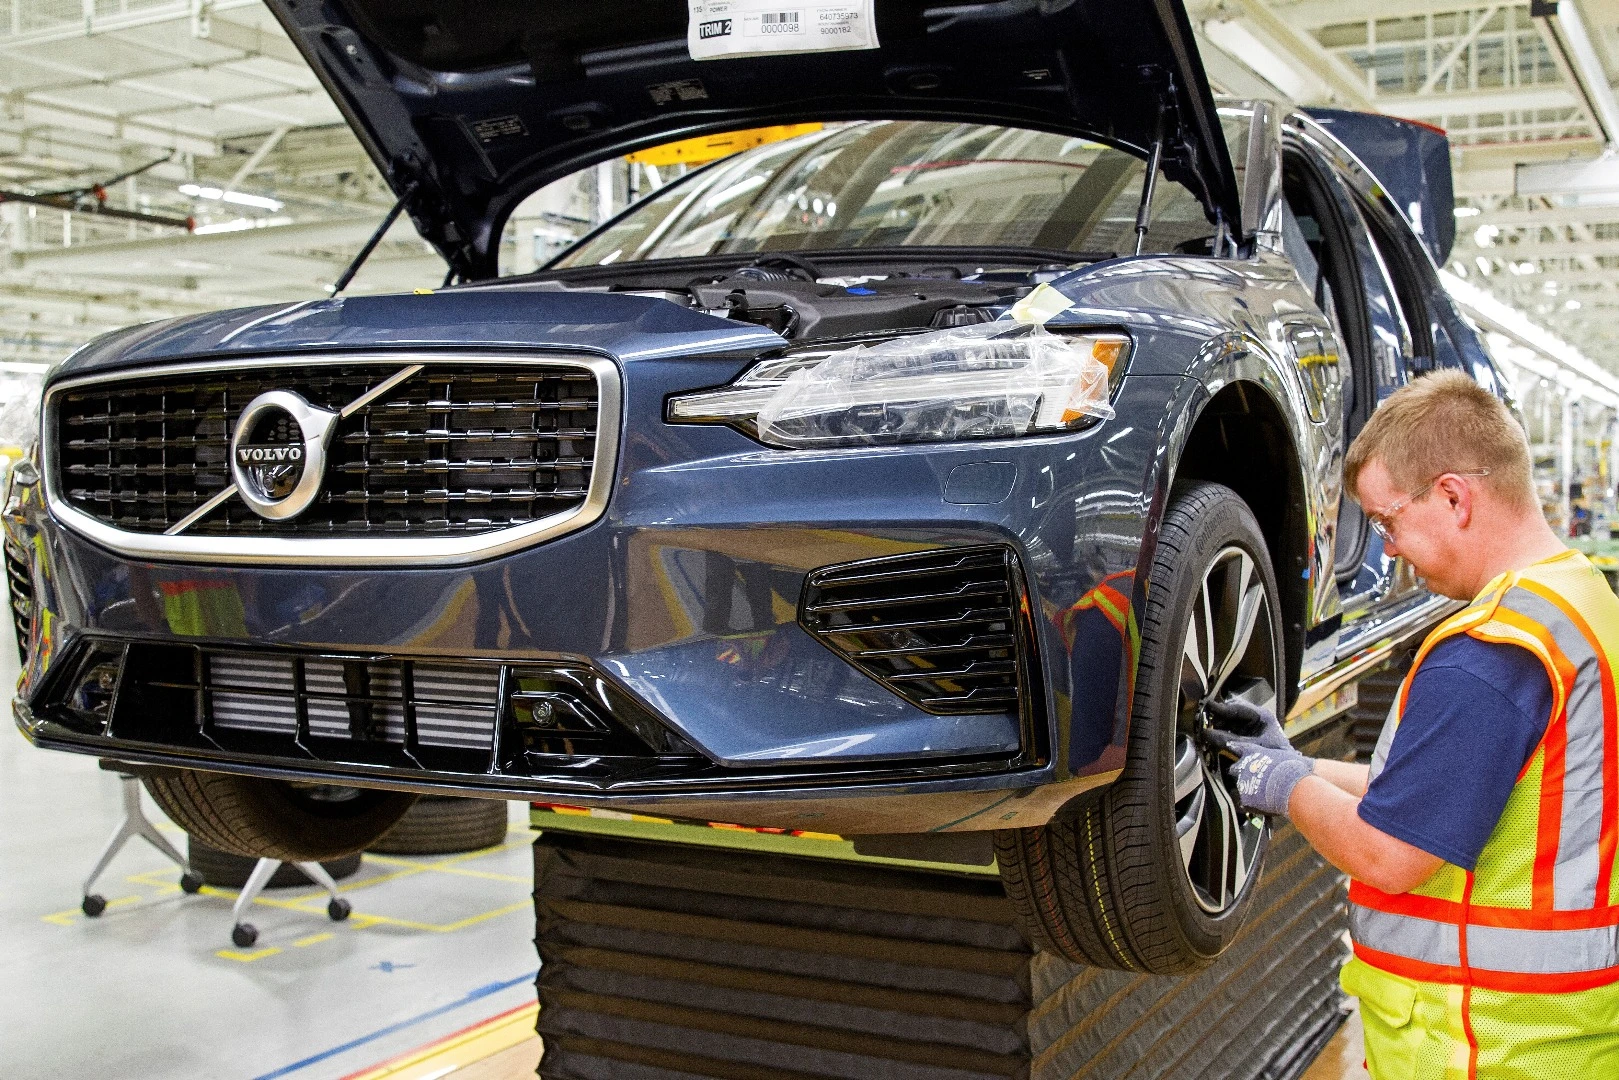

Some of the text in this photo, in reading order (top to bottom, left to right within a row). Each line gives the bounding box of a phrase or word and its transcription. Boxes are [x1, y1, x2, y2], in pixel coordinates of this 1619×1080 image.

[700, 21, 731, 37] TRIM 2
[761, 23, 799, 33] 0000098
[820, 26, 851, 34] 9000182
[238, 447, 301, 461] VOLVO
